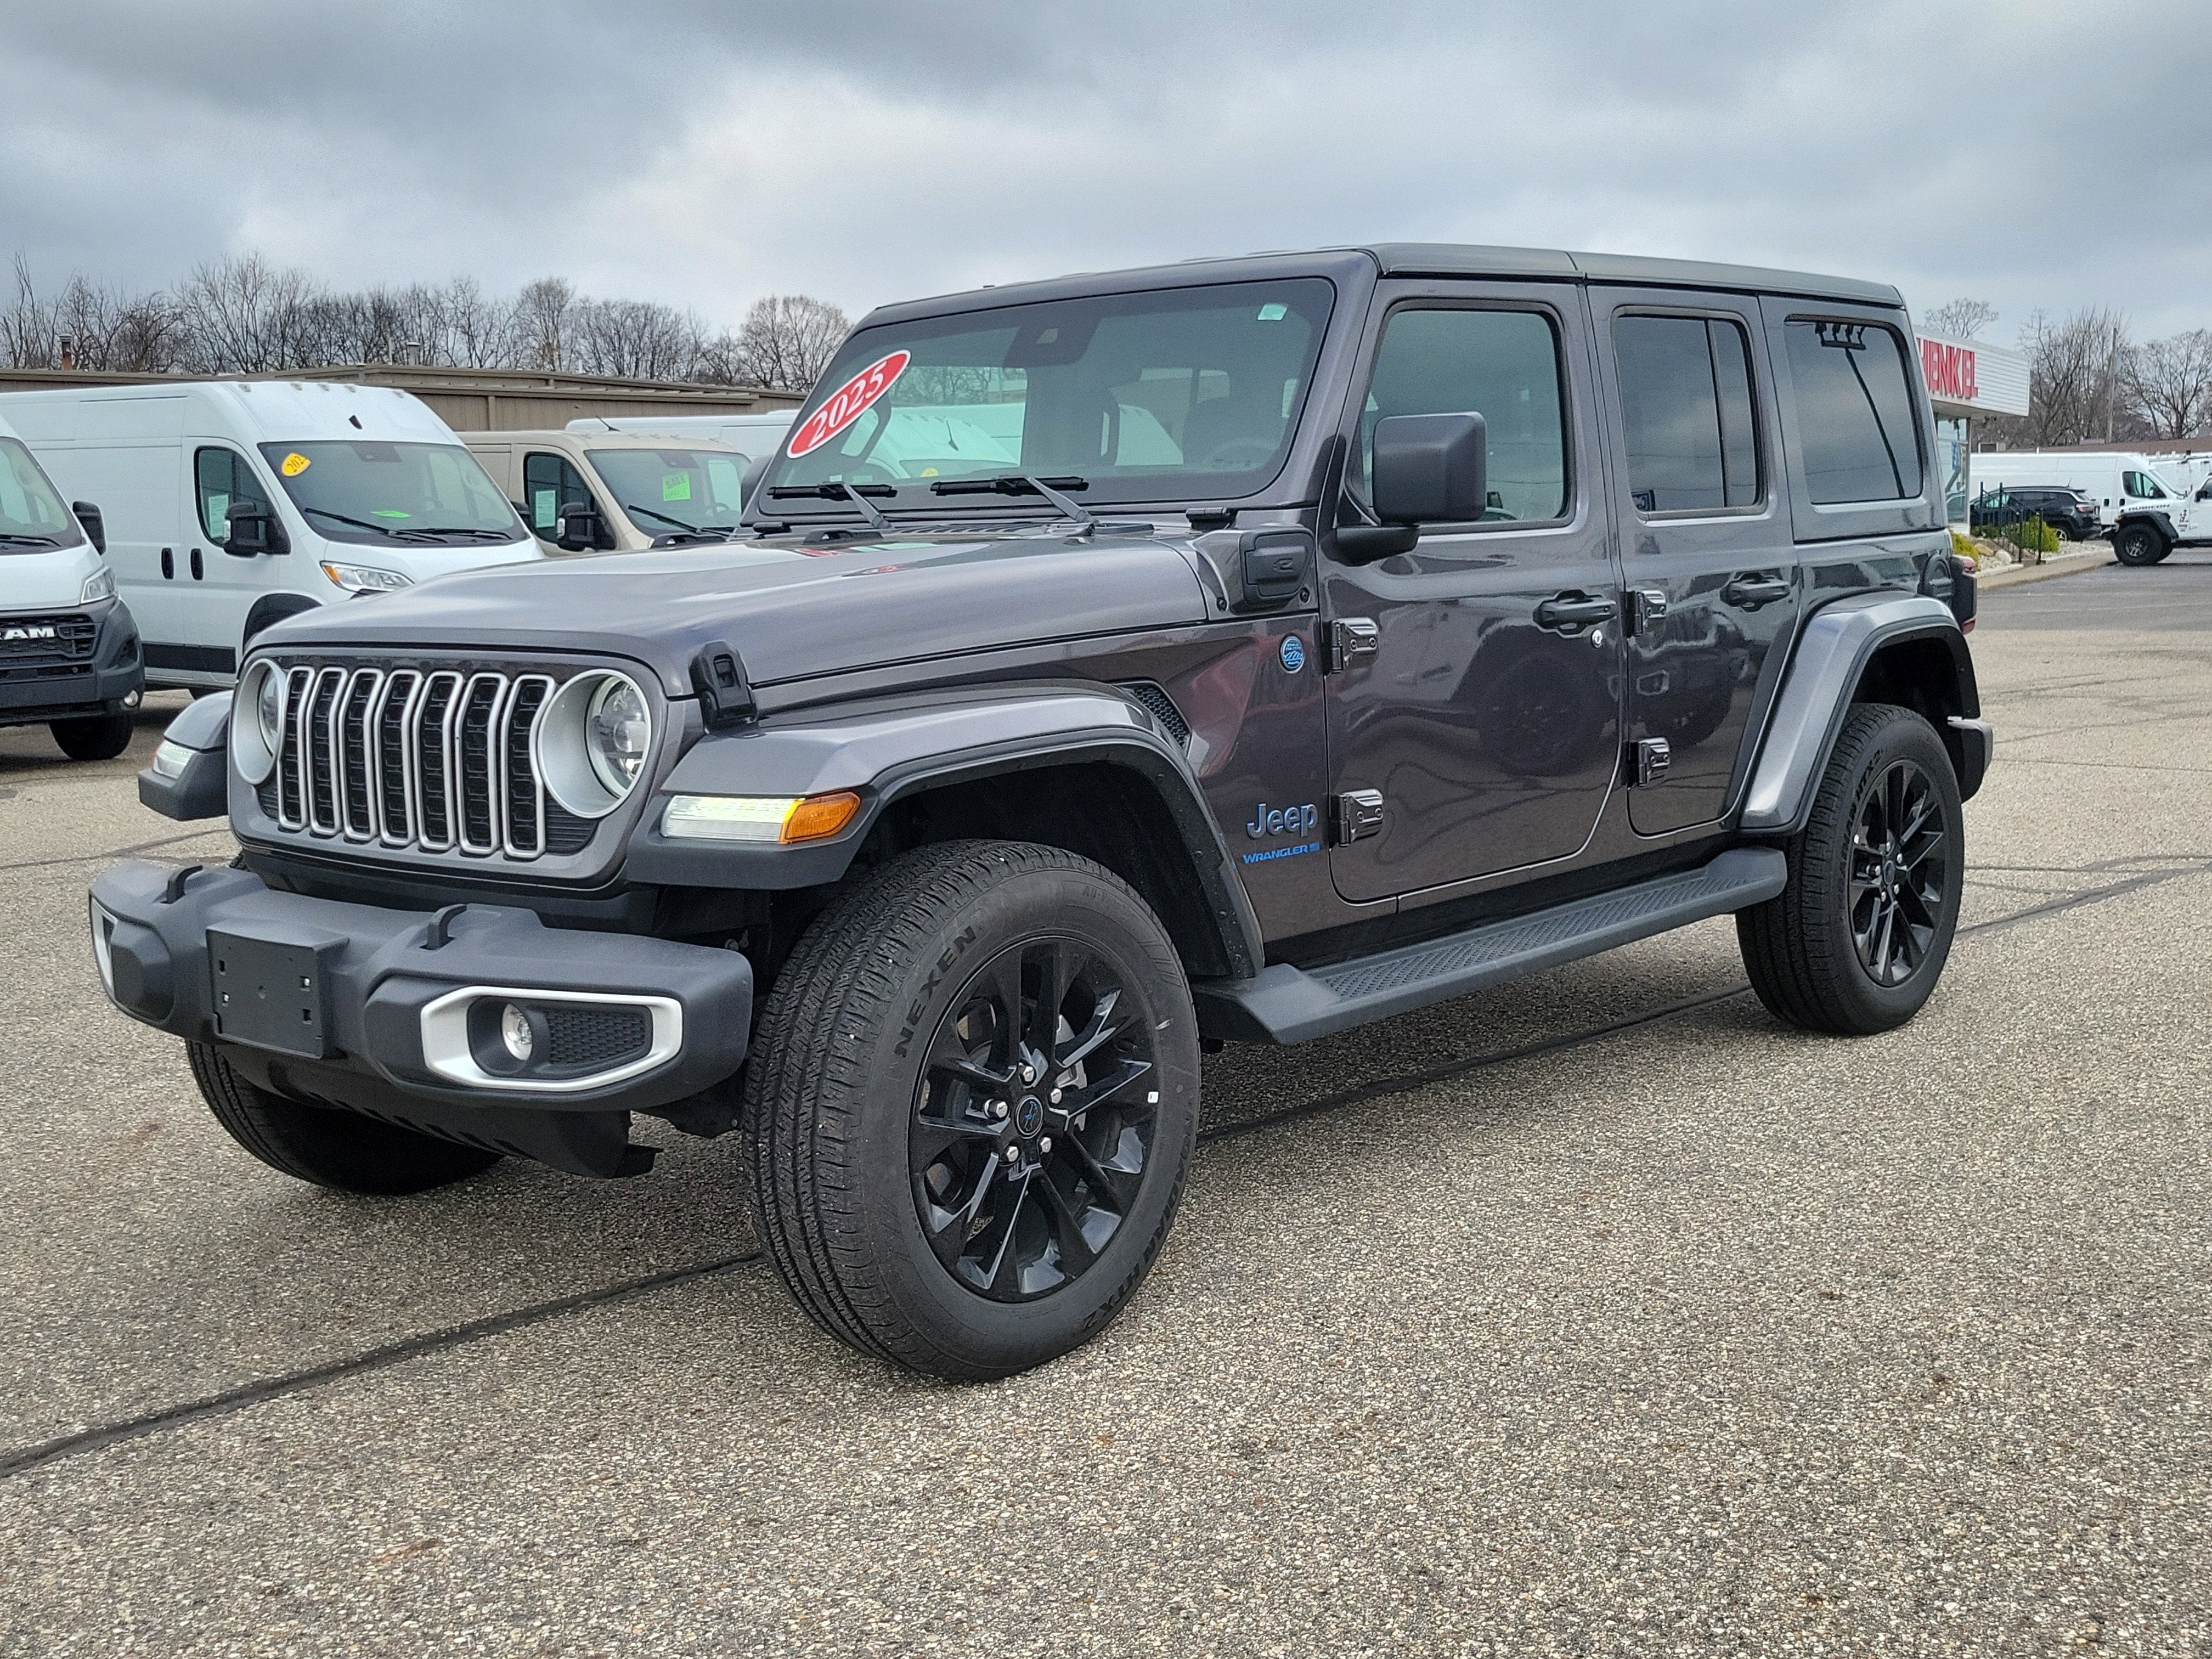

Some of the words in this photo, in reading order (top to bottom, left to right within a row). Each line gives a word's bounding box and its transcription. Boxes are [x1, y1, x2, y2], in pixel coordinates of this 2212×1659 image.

[808, 360, 888, 448] 2025
[287, 455, 306, 472] 202
[0, 627, 55, 640] AM
[1246, 803, 1318, 839] Jeep
[1243, 844, 1308, 865] WRANGLER
[893, 925, 977, 1058] NEXEN
